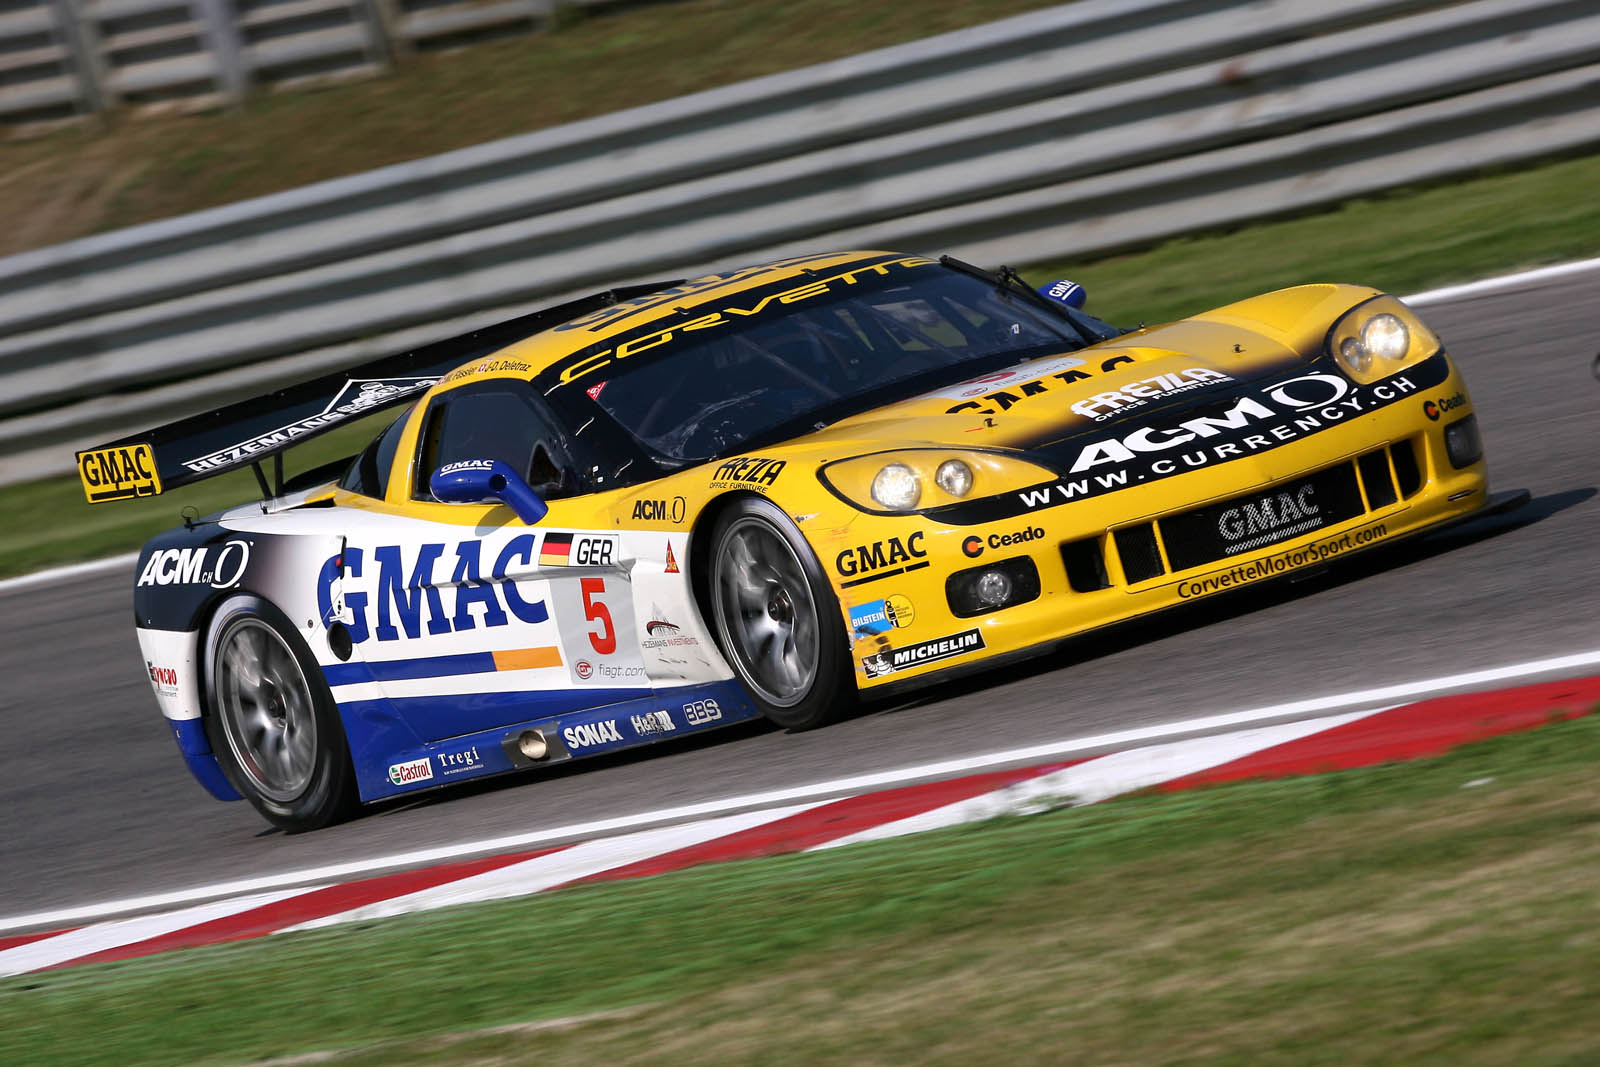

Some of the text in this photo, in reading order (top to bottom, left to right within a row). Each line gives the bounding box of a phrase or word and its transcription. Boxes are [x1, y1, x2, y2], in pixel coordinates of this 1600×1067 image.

[559, 256, 933, 385] CORVETTE
[1095, 376, 1236, 422] OFFICE FURNITURE
[187, 411, 350, 473] HEZEMANS
[1019, 376, 1418, 508] WWW.CURRENCY.CH
[81, 445, 153, 488] GMAC
[440, 459, 495, 474] GMAC
[709, 481, 768, 494] OFFICE FURNITURE
[1217, 483, 1320, 542] GMAC
[577, 538, 613, 566] GER
[835, 530, 928, 577] GMAC
[988, 525, 1045, 550] Ceado
[1177, 522, 1388, 599] CorvetteMotorSport.com
[317, 533, 549, 644] GMAC
[581, 577, 617, 655] 5
[852, 611, 886, 628] BILSTEIN
[894, 633, 978, 666] MICHELIN
[682, 698, 722, 727] BBS
[563, 719, 624, 750] SONAX
[400, 760, 432, 783] Castrol
[437, 746, 480, 766] Tregi
